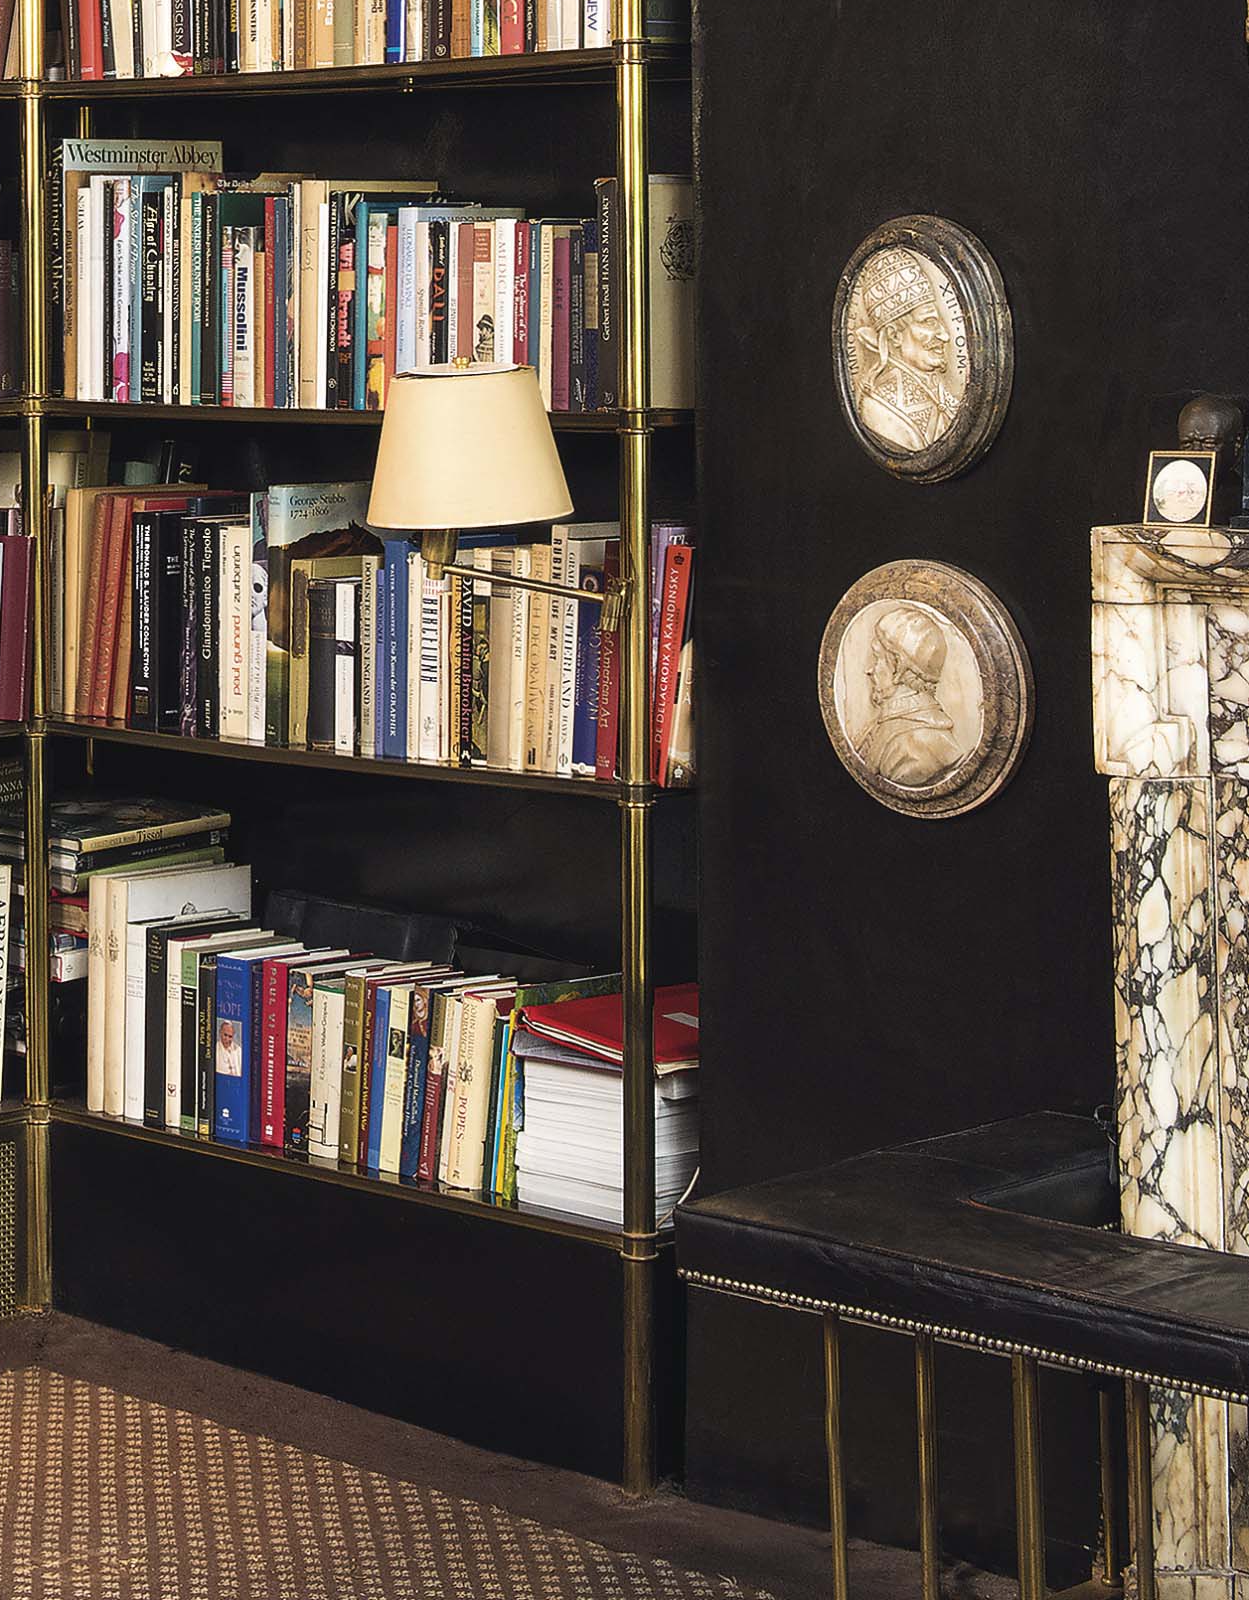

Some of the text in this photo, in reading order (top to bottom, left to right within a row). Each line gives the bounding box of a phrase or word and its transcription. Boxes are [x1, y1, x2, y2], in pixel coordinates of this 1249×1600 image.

[67, 143, 219, 166] Westminster Abbey
[51, 145, 63, 305] Westminster Abbey
[236, 266, 248, 351] Mussolini
[289, 495, 347, 507] George Stubbs
[202, 527, 212, 660] Giandomenico Tiepolo
[462, 632, 472, 673] Anita
[657, 656, 670, 722] DELACROIX
[665, 568, 679, 637] KANDINSKY
[601, 647, 614, 705] American
[461, 676, 471, 743] Brookner
[600, 707, 612, 728] Art
[268, 967, 277, 1006] PAUL
[456, 1096, 468, 1140] POPES
